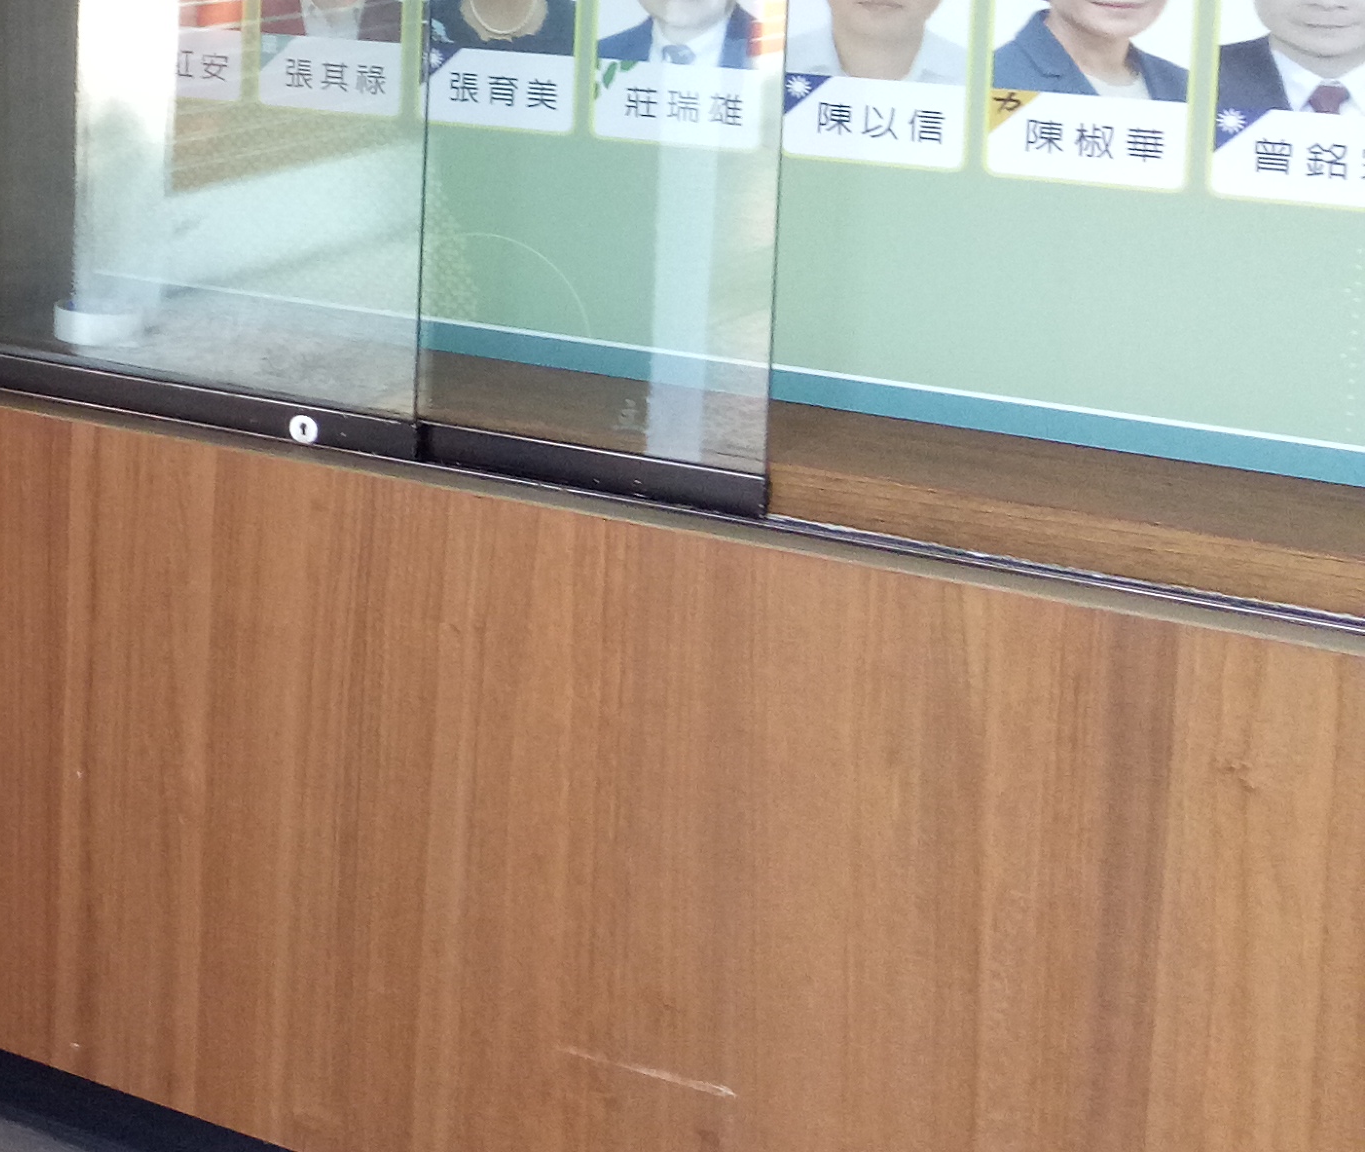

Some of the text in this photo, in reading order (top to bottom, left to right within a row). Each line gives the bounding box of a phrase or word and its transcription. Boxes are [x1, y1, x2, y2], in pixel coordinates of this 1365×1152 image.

[449, 70, 559, 111] 張育美
[624, 85, 743, 128] 莊瑞雄
[817, 101, 946, 145] 陳以信
[1024, 119, 1164, 163] 陳椒華
[1254, 136, 1365, 181] 曾銘
